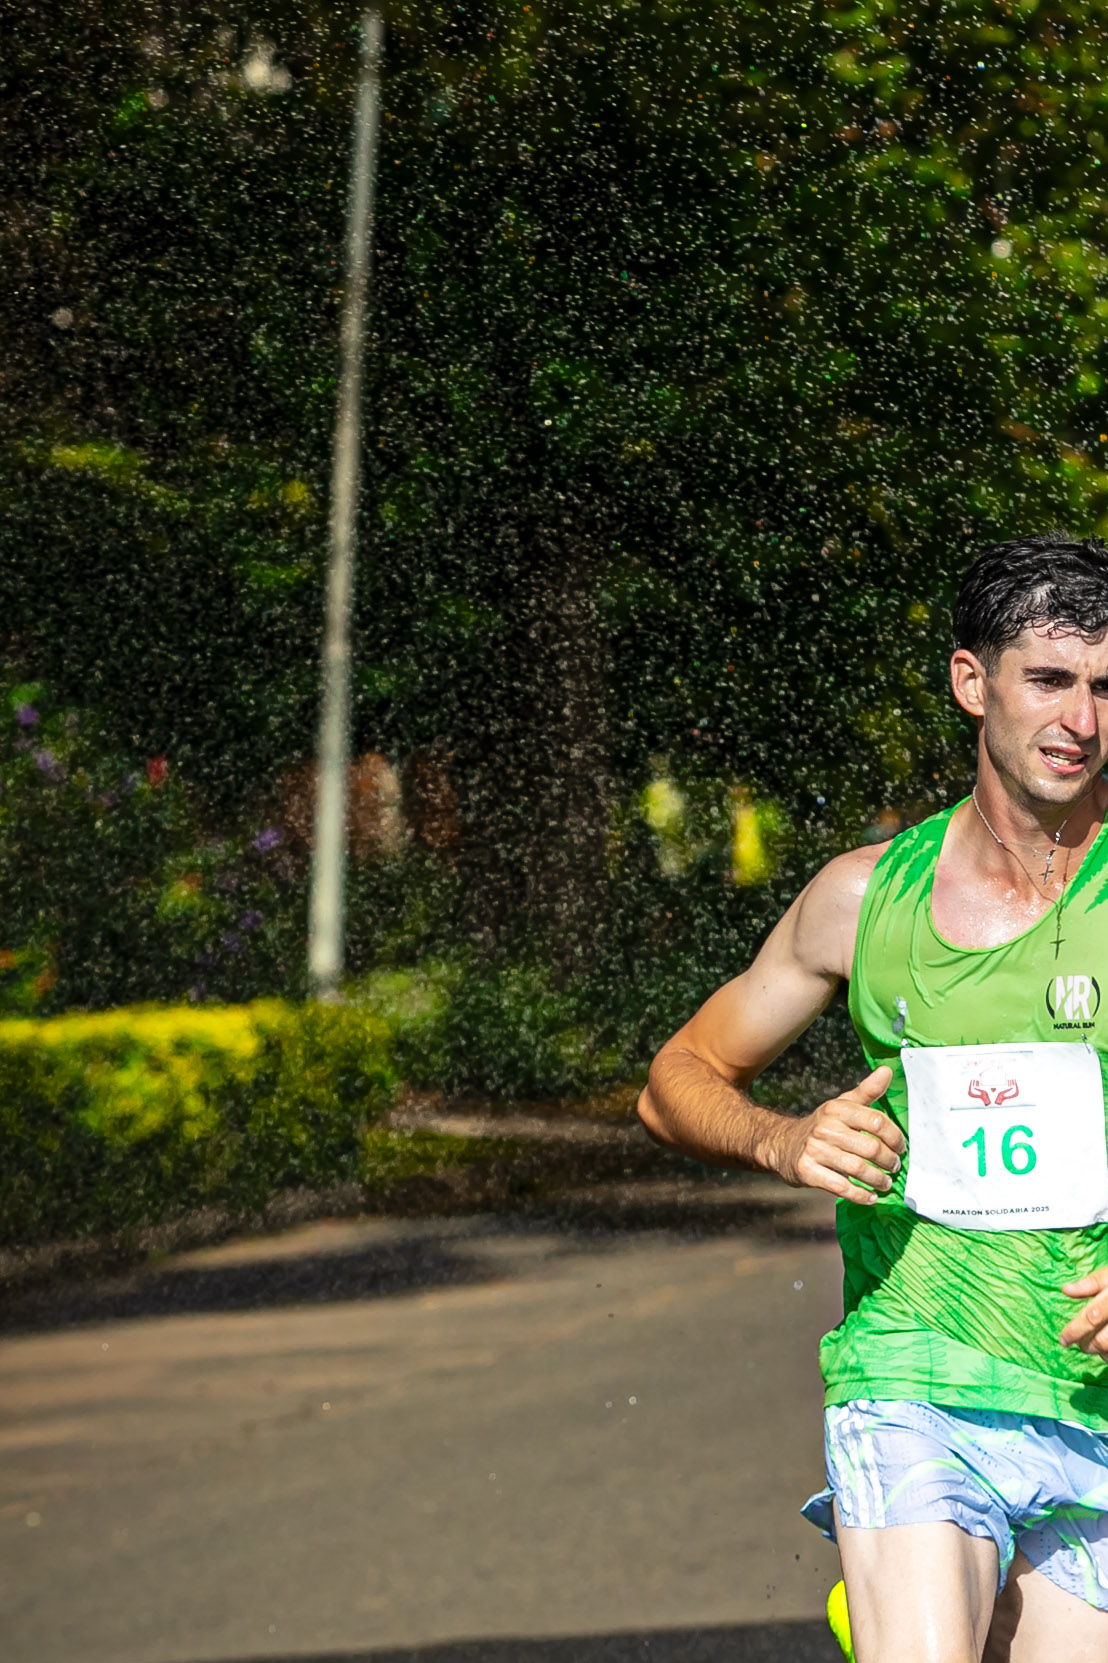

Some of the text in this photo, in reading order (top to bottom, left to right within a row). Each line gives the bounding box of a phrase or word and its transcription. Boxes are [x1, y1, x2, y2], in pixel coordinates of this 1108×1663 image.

[1053, 1022, 1081, 1030] NATURAL
[962, 1124, 1037, 1177] 16
[985, 1207, 1029, 1216] SOLIDARIA
[1031, 1205, 1050, 1213] 2025
